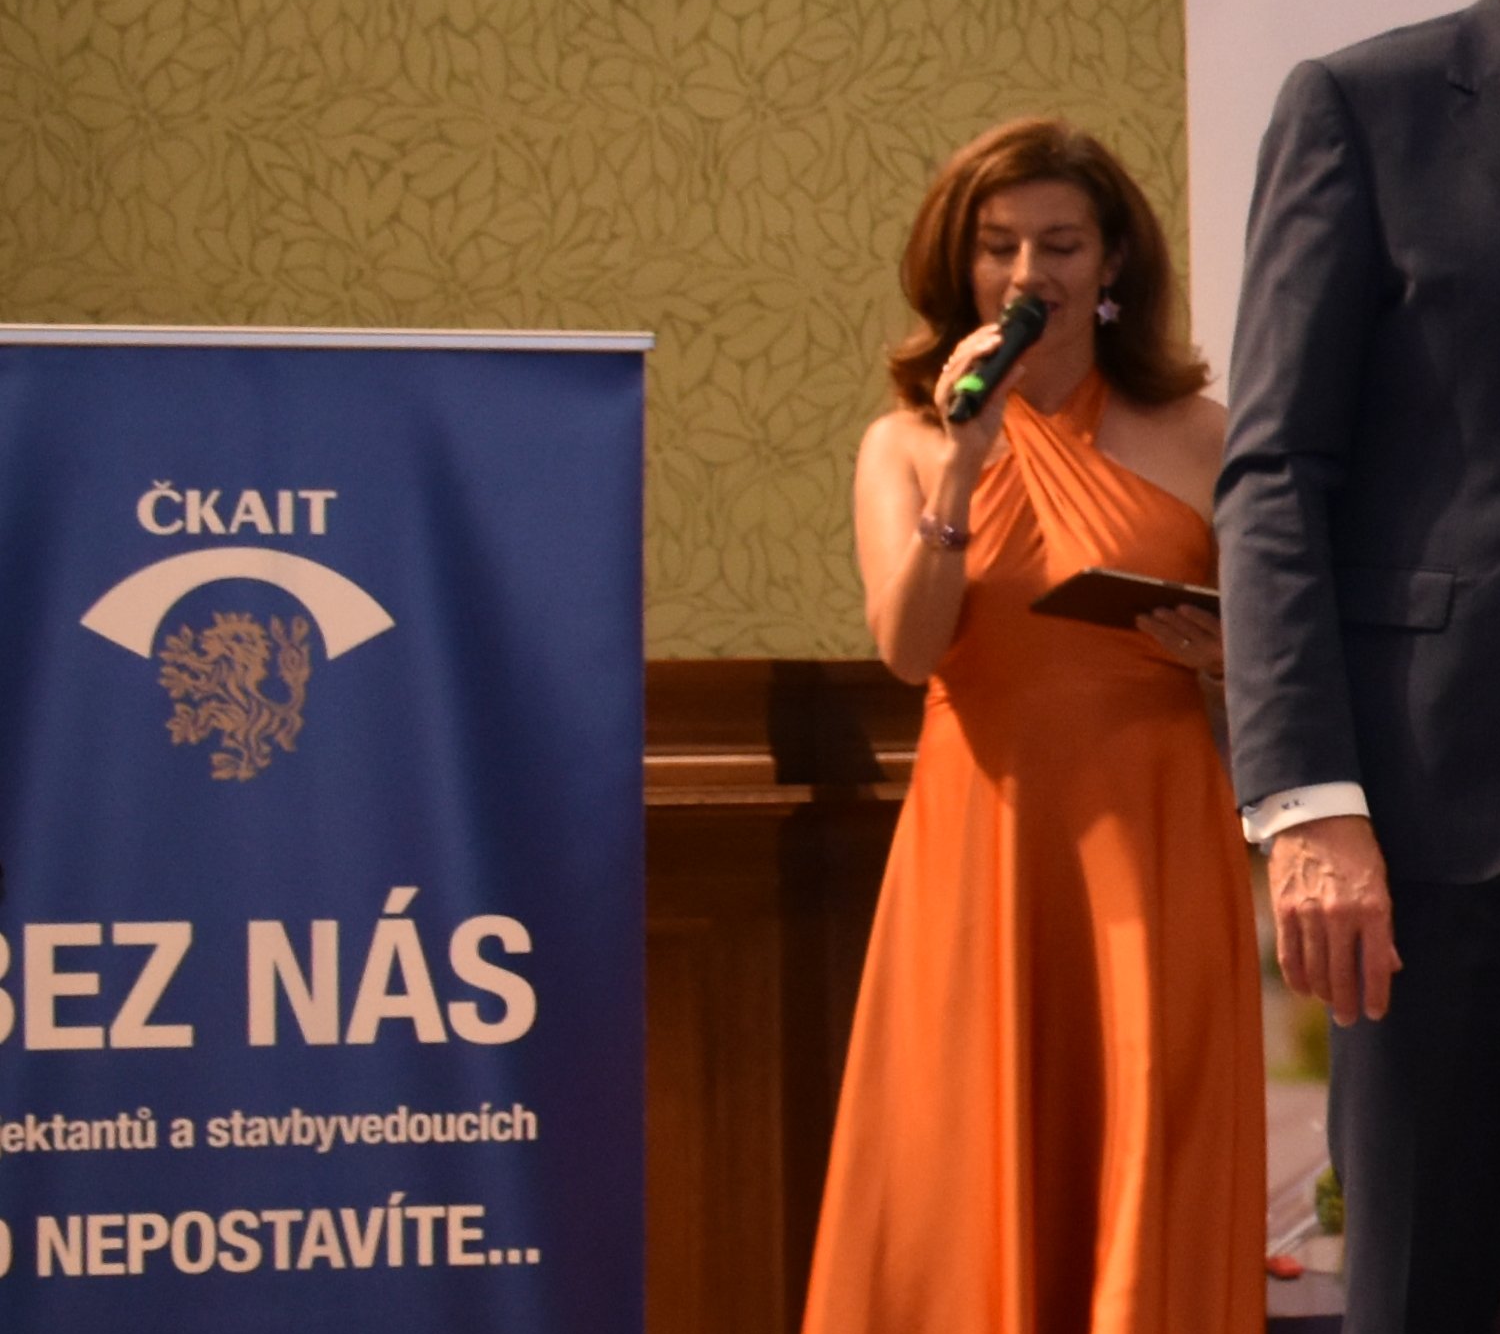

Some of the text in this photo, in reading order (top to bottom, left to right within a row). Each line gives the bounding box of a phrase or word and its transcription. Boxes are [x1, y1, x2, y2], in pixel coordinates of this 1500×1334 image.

[136, 479, 338, 536] ČKAIT
[247, 886, 537, 1046] NÁS
[170, 1117, 194, 1149] a
[206, 1103, 538, 1153] stavbyvedoucích
[36, 1191, 541, 1278] NEPOSTAVÍTE...
